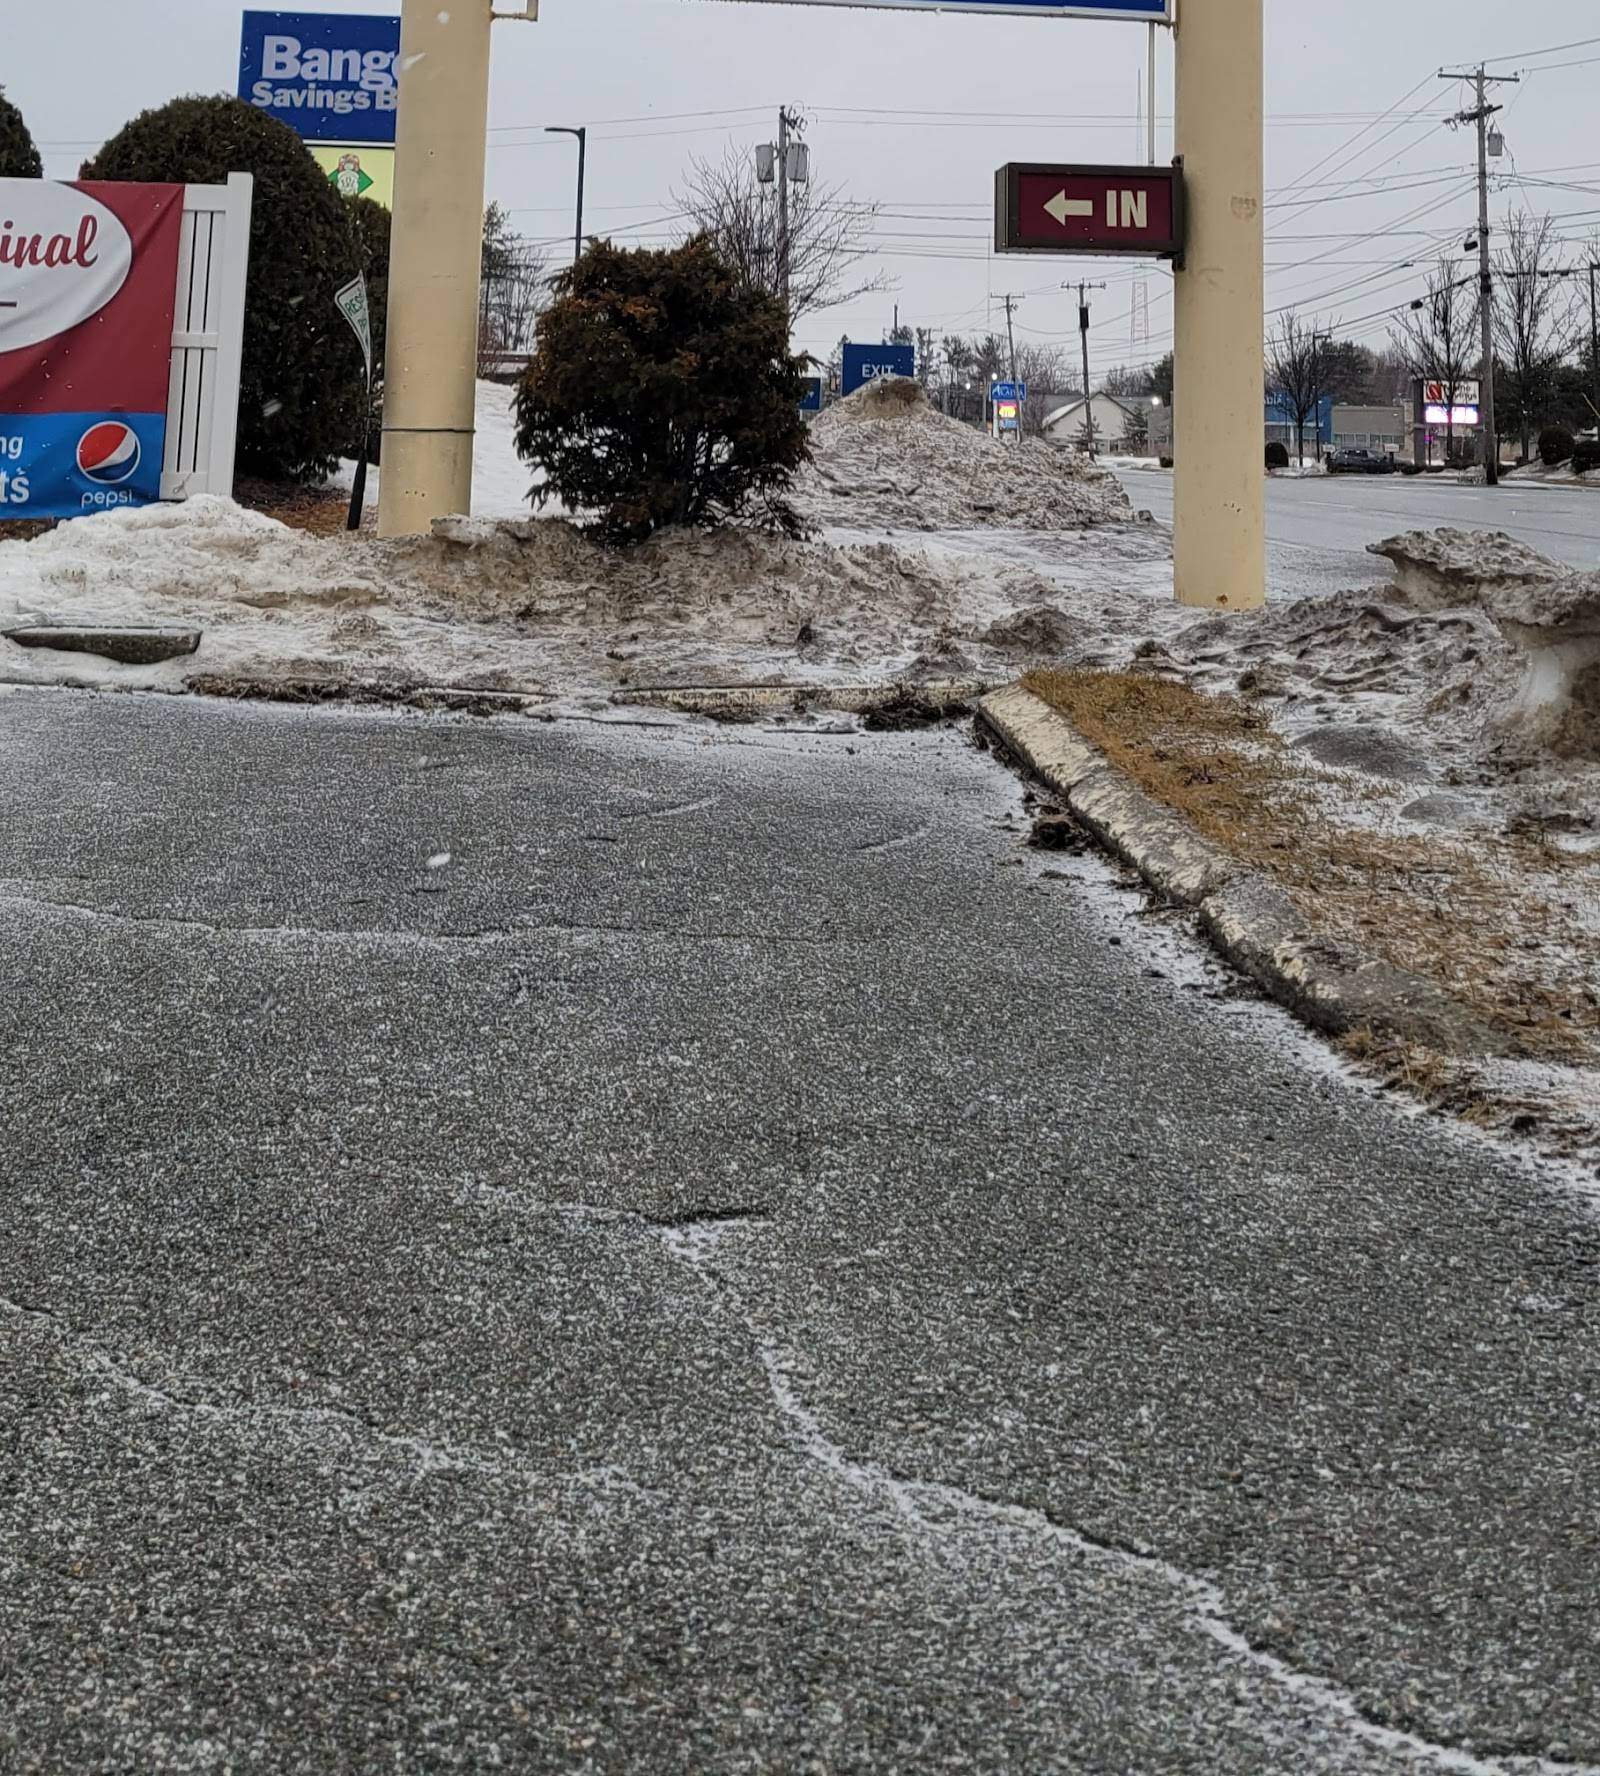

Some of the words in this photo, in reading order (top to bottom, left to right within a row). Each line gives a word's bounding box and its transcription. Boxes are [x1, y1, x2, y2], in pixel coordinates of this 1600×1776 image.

[251, 81, 371, 114] Savings
[1106, 190, 1147, 228] IN
[861, 364, 895, 378] EXIT
[81, 489, 133, 509] pepsi
